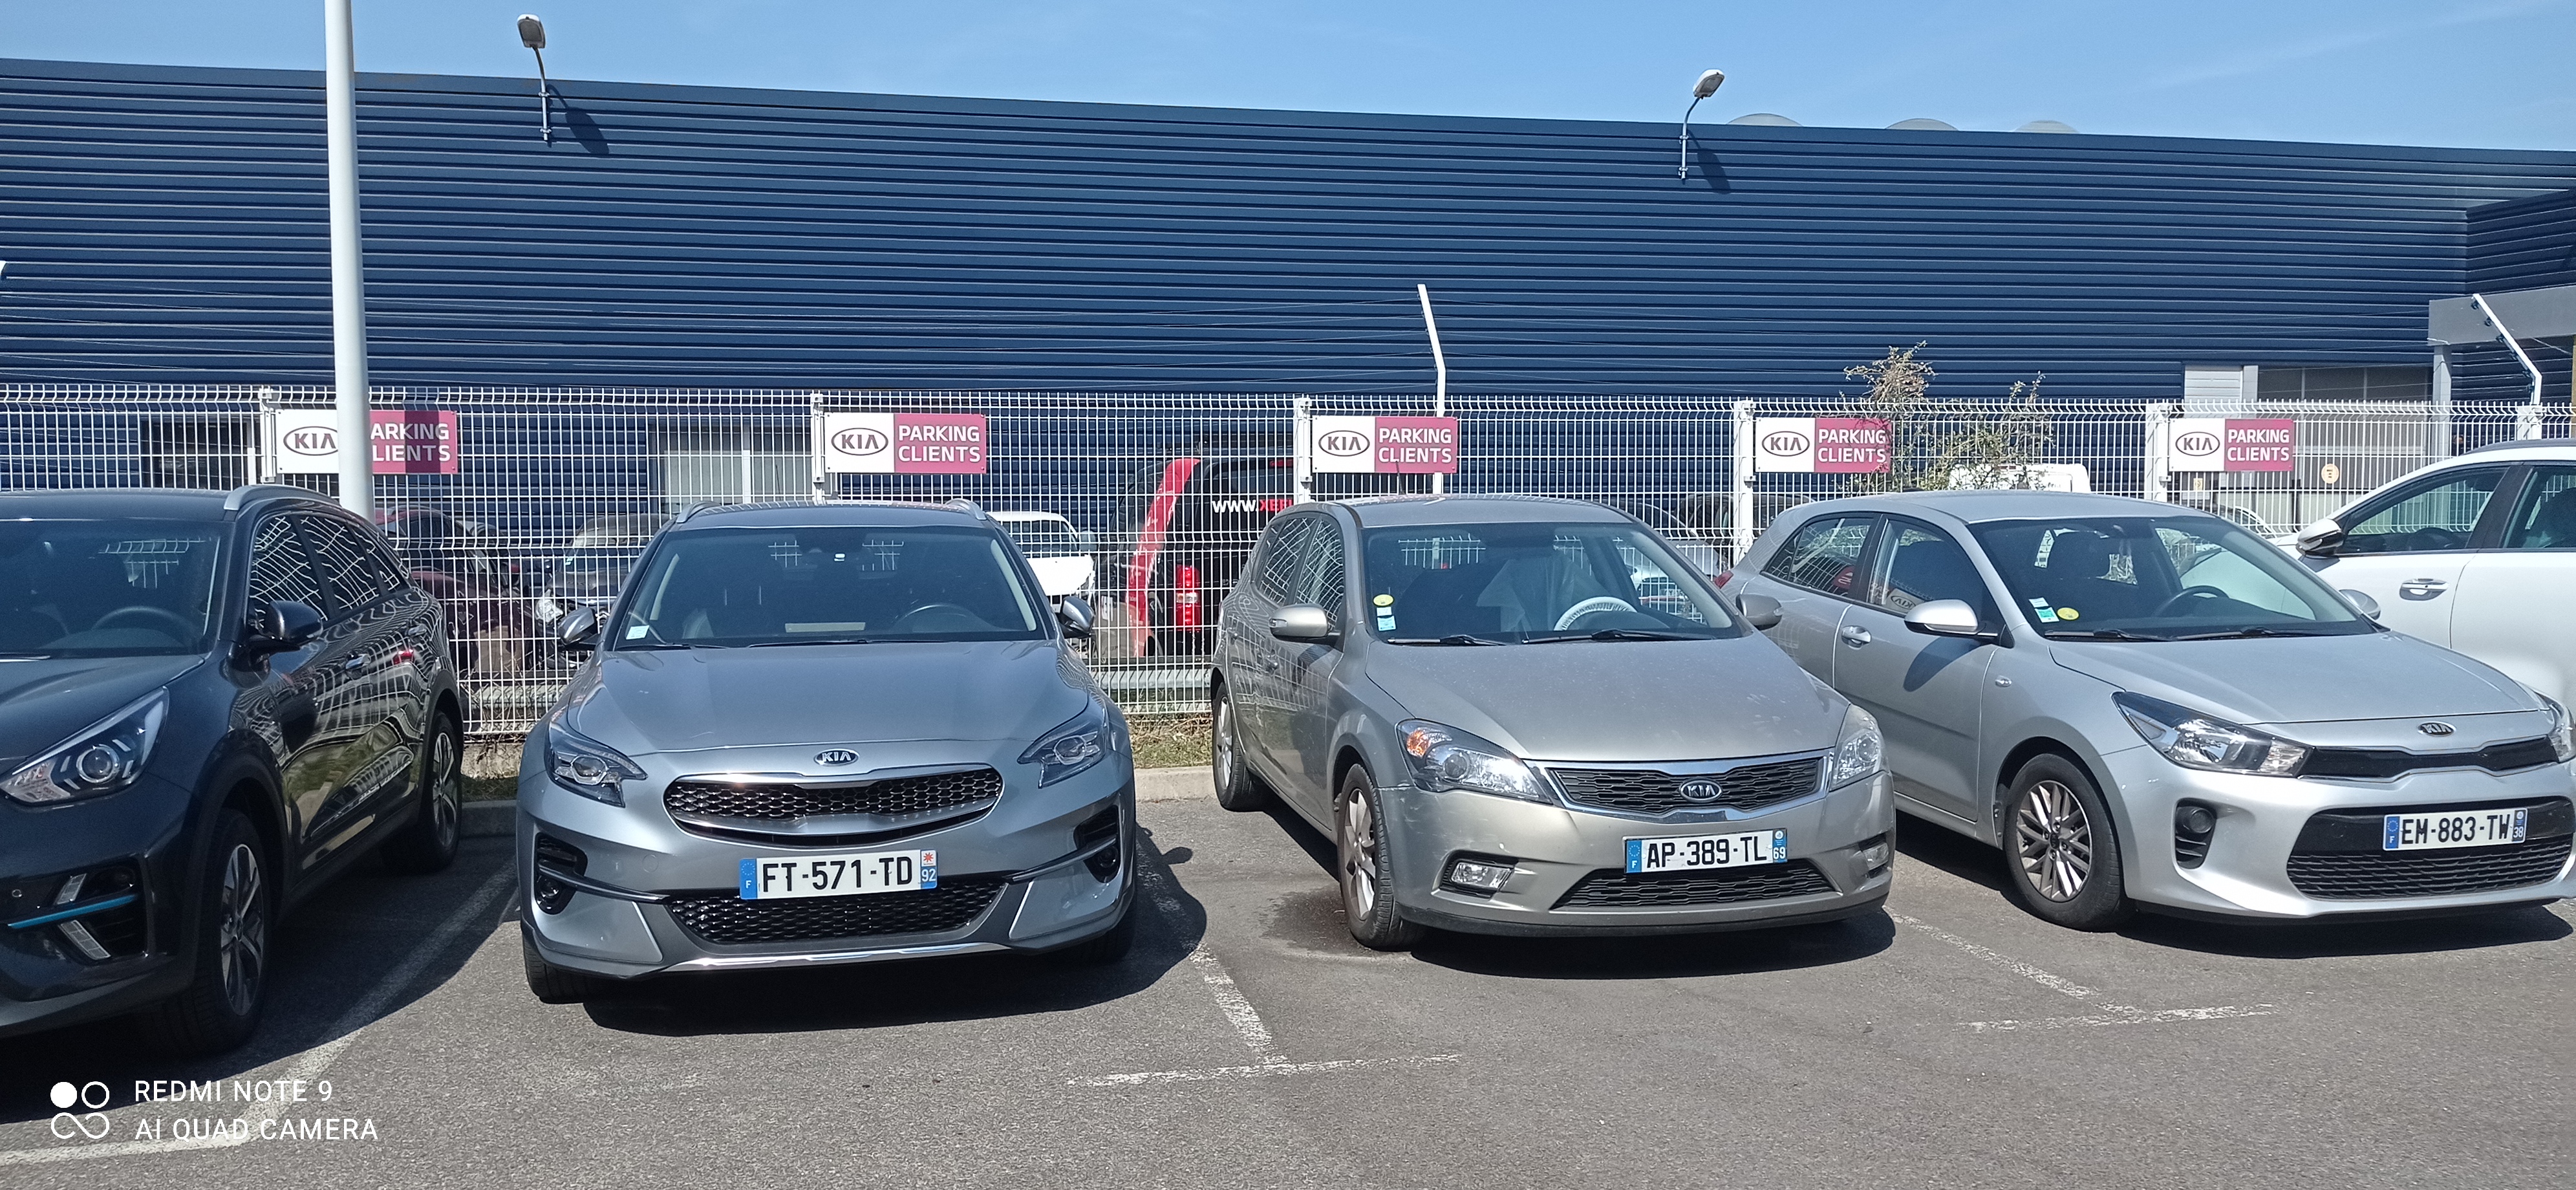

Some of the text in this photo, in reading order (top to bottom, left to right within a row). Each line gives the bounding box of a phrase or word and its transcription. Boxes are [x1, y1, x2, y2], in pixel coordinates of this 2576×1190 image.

[370, 423, 449, 440] ARKING
[899, 425, 980, 442] PARKING
[1379, 428, 1452, 443] PARKING
[1818, 429, 1886, 444] PARKING
[2228, 429, 2290, 443] PARKING
[294, 433, 336, 449] KIA
[841, 434, 879, 449] KIA
[1327, 437, 1361, 451] KIA
[1770, 437, 1801, 451] KIA
[2184, 437, 2213, 450] KIA
[372, 444, 451, 462] LIENTS
[898, 446, 980, 462] CLIENTS
[1379, 447, 1452, 463] CLIENTS
[1818, 448, 1886, 463] CLIENTS
[2227, 447, 2290, 461] CLIENTS
[2422, 723, 2451, 733] KIA
[822, 751, 852, 763] KIA
[1687, 784, 1715, 797] KIA
[2401, 814, 2510, 845] EM-883-TW
[2513, 826, 2524, 839] 38
[1631, 860, 1638, 869] F
[1647, 836, 1767, 869] AP-389-TL
[1773, 847, 1786, 860] 69
[746, 856, 936, 892] F FT-571-TD 92
